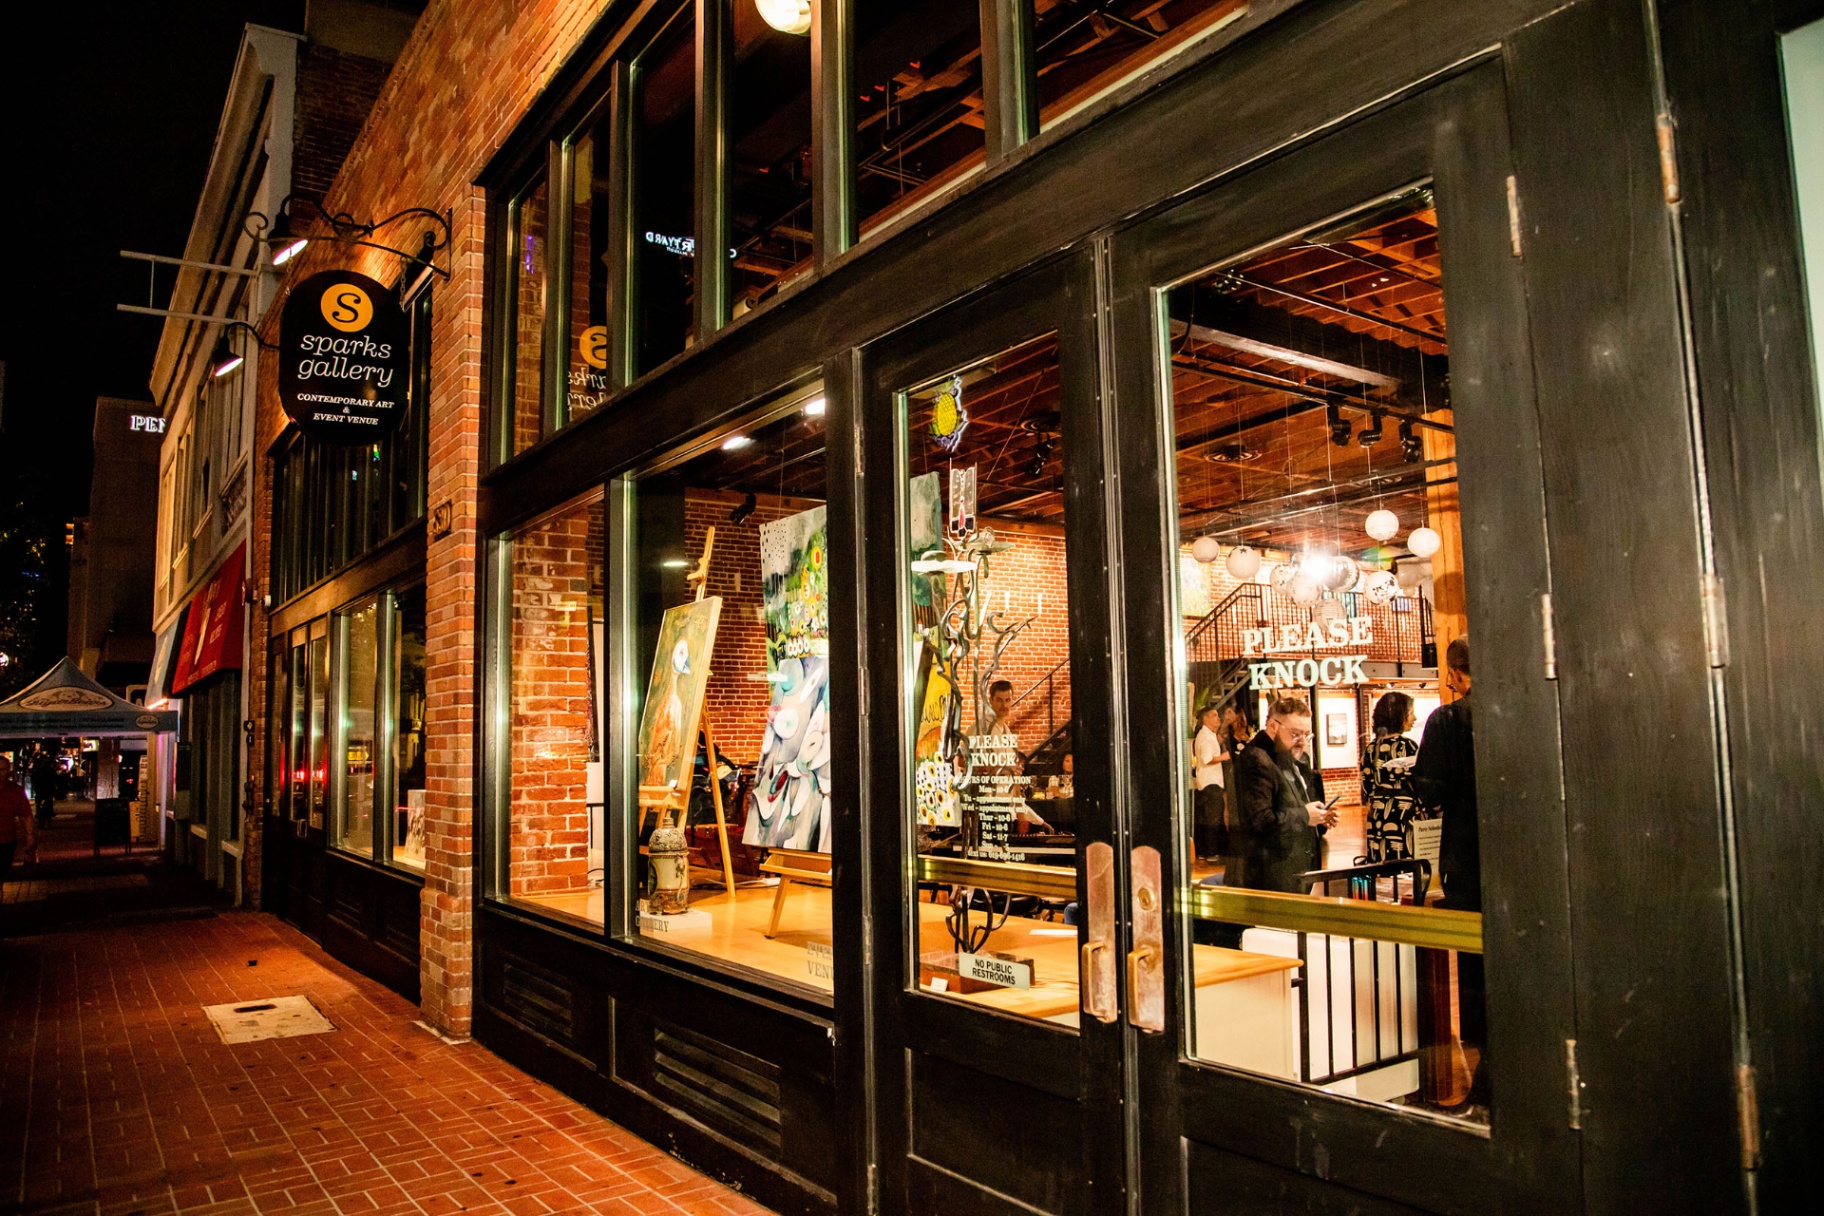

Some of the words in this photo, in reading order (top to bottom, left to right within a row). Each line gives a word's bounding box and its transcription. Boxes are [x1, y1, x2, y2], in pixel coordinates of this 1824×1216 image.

[332, 293, 361, 323] S
[300, 334, 392, 359] sparks
[297, 356, 394, 388] gallery
[297, 393, 375, 408] CONTEMPORARY
[375, 400, 395, 409] ART
[342, 406, 350, 414] &
[313, 413, 346, 423] EVENT
[347, 415, 379, 426] VENUE
[1241, 615, 1374, 655] PLEASE
[1248, 655, 1370, 690] KNOCK
[968, 734, 1018, 749] PLEASE
[970, 752, 1016, 767] KNOCK
[981, 775, 990, 784] OF
[991, 776, 1031, 785] OPERATION
[979, 812, 994, 821] Thur
[982, 822, 991, 830] Fri
[982, 831, 993, 840] Sat
[975, 959, 985, 968] NO
[987, 961, 1012, 974] PUBLIC
[973, 968, 1015, 984] RESTROOMS
